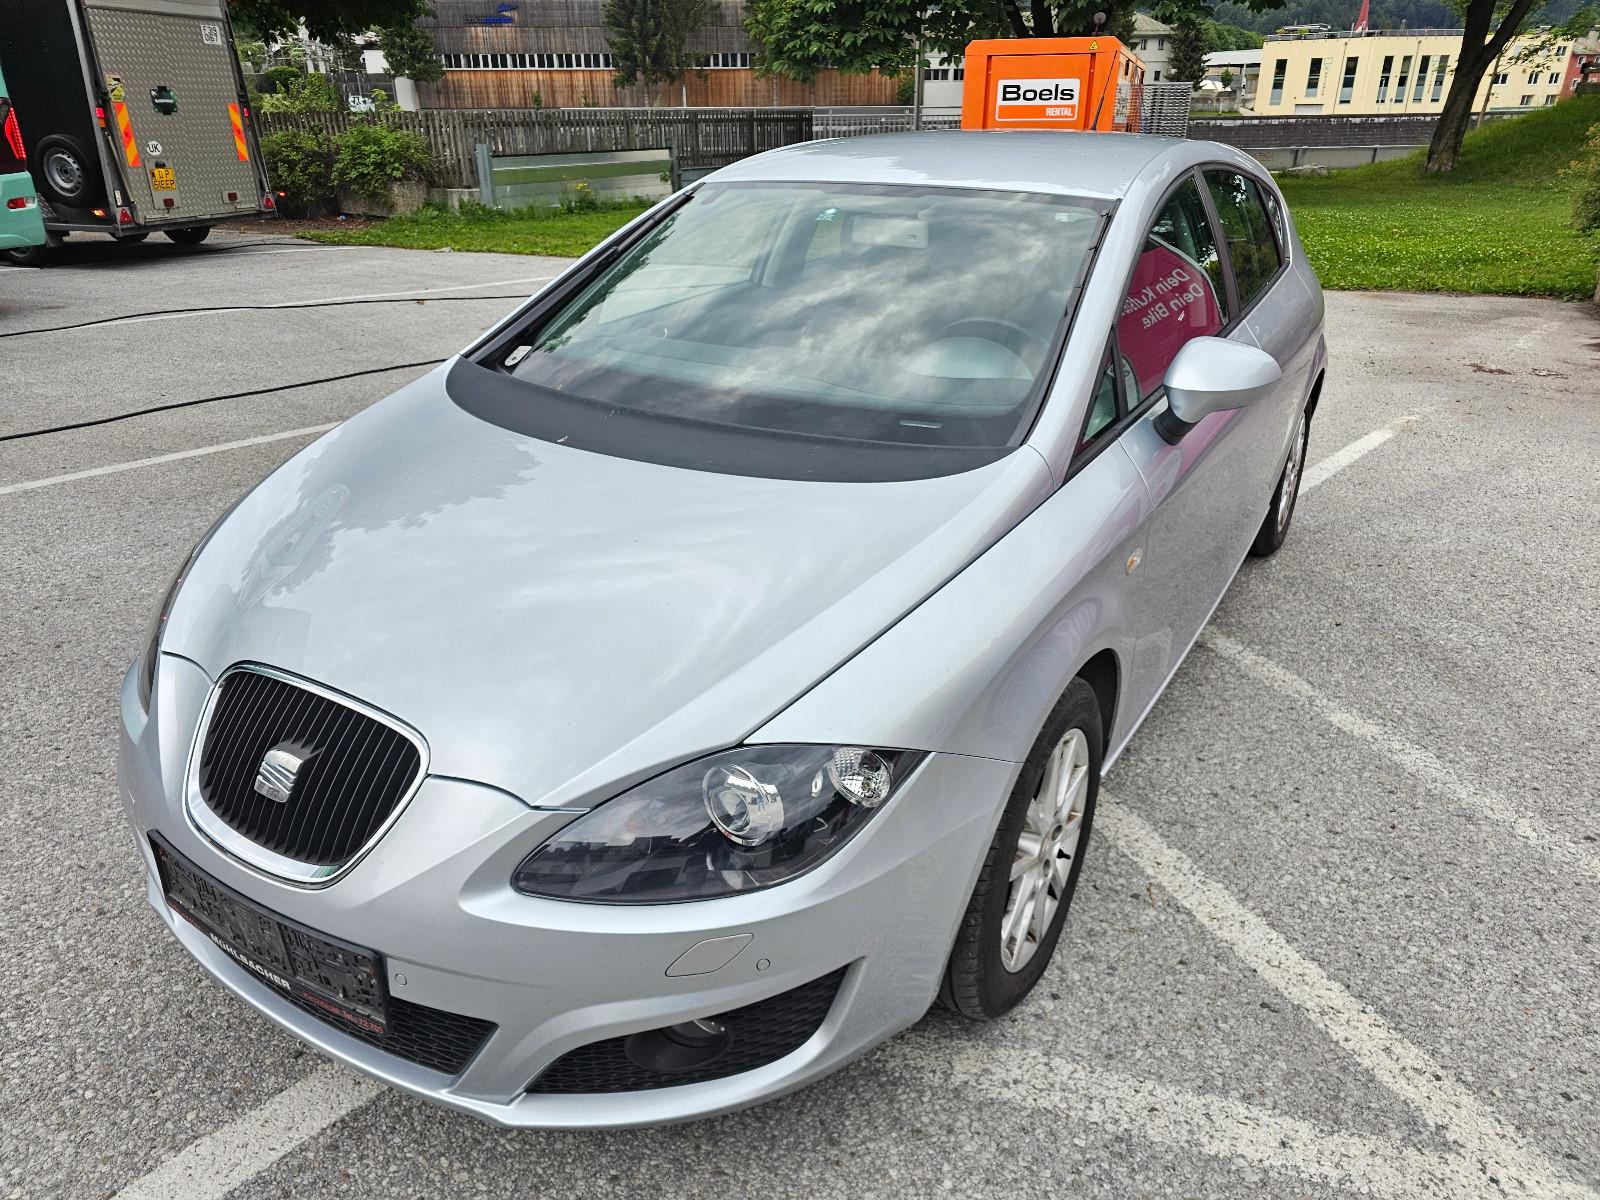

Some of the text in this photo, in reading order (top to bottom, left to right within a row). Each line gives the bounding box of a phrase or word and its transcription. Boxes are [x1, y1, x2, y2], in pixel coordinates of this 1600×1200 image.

[1002, 84, 1075, 101] Boels
[1045, 107, 1073, 117] RENTAL
[148, 143, 161, 153] UK
